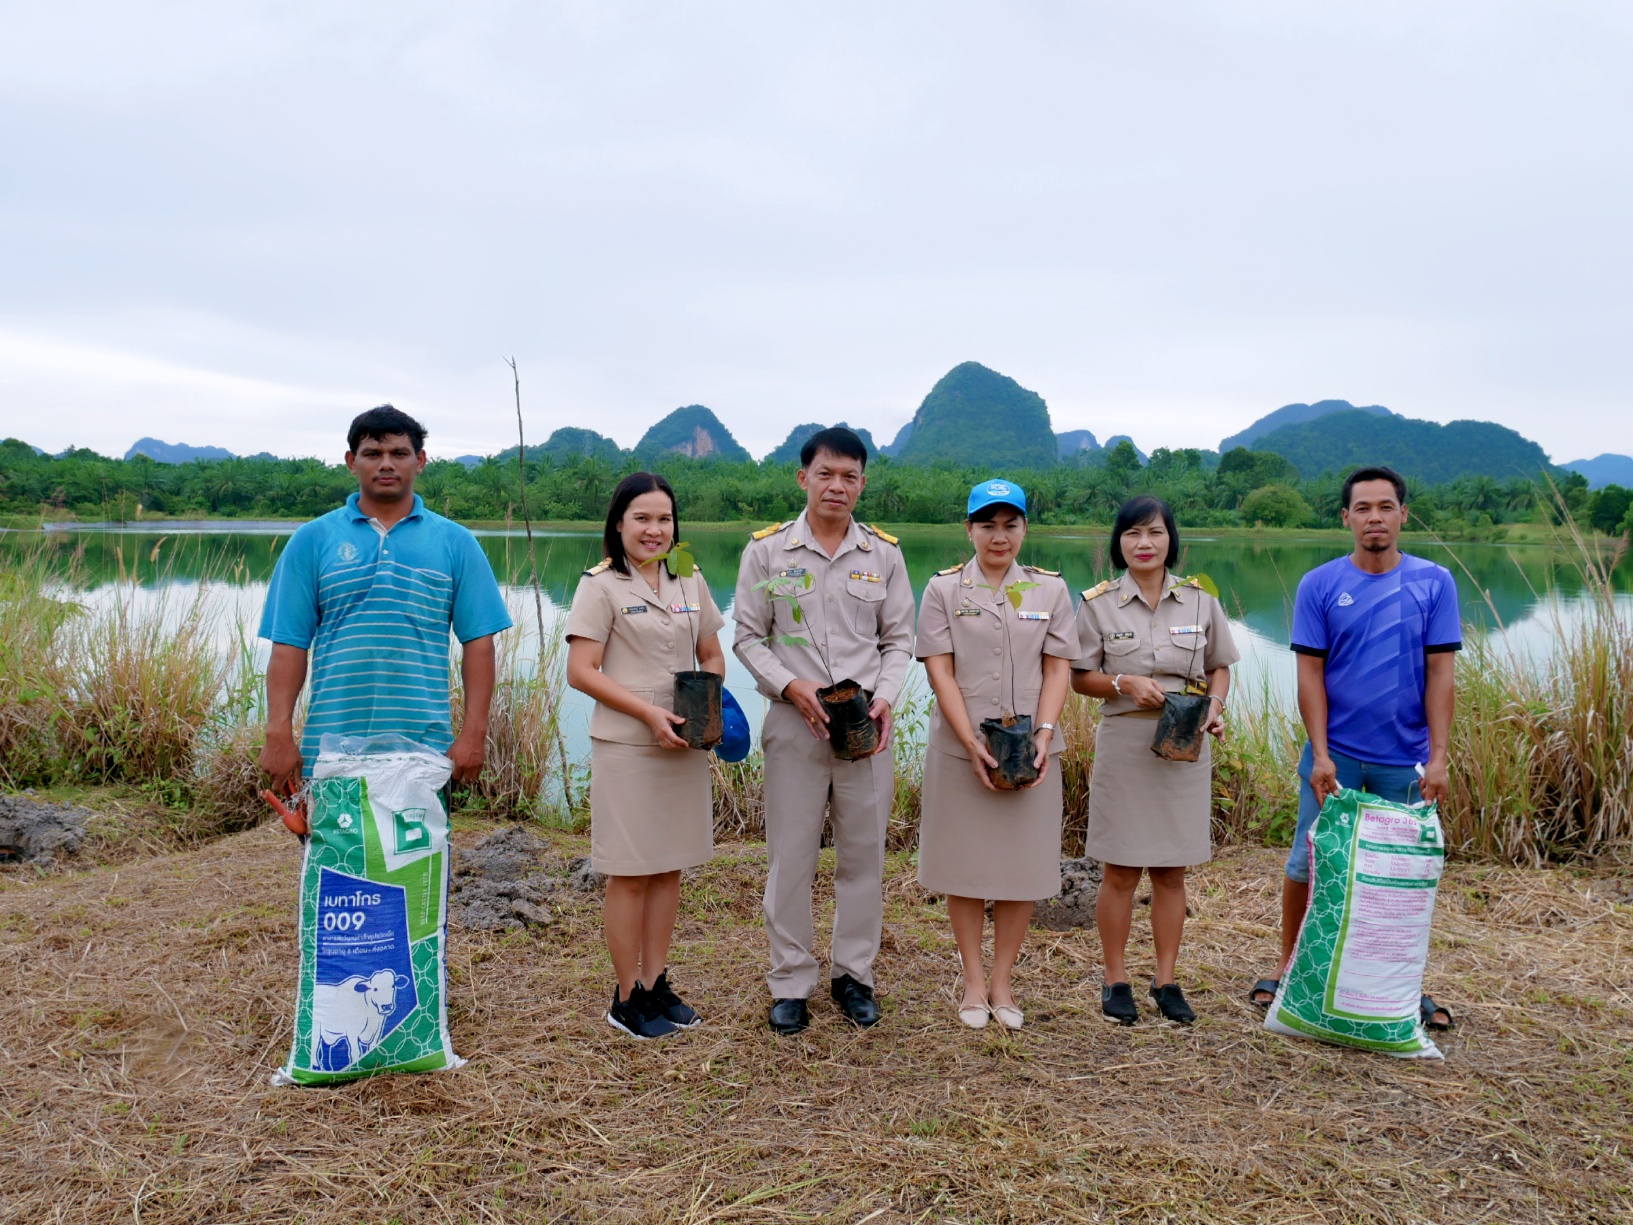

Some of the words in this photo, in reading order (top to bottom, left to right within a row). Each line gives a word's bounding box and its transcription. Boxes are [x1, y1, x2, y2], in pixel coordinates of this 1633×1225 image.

[1364, 813, 1400, 826] Betagro
[324, 890, 381, 907] เบทาโกร
[324, 911, 366, 931] 009
